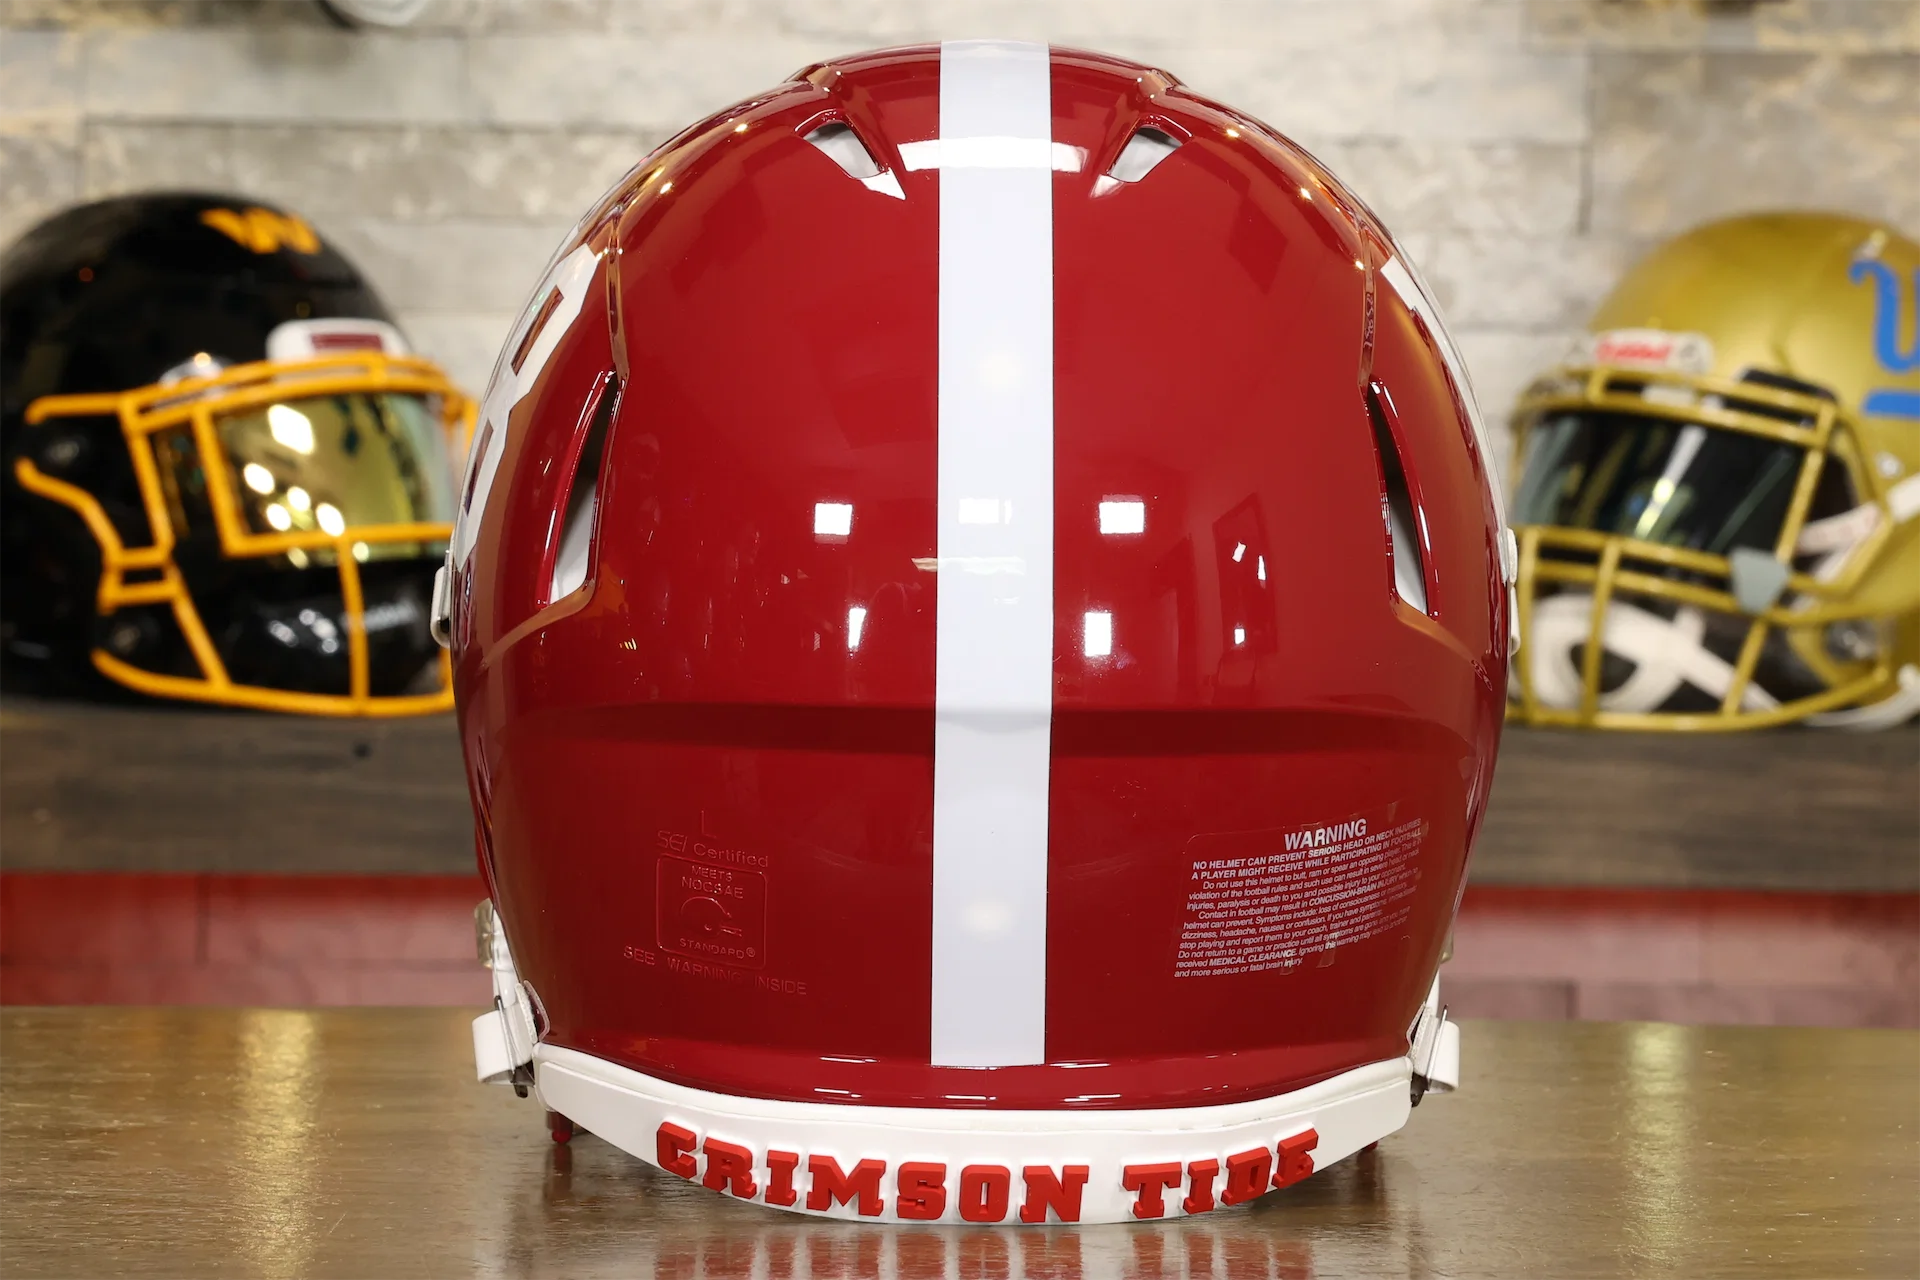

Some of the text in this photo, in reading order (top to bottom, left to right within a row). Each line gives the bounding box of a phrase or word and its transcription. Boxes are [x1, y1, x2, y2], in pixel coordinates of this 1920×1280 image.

[656, 829, 769, 868] SEI Certified
[1193, 817, 1421, 870] NO HELMET CAN PREVENT SERIOUS HEAD OR NECK INJURIES
[1284, 818, 1367, 851] WARNING
[1191, 828, 1421, 880] A PLAYER MIGHT RECEIVE WHILE PARTICIPATING IN FOOTBALL
[1203, 881, 1215, 890] Do
[1216, 881, 1229, 889] not
[1230, 880, 1244, 888] use
[1245, 878, 1258, 887] this
[1259, 875, 1284, 885] helmet
[1308, 869, 1322, 878] ram
[1330, 863, 1349, 874] spear
[1349, 861, 1358, 869] an
[1358, 853, 1384, 868] opposing
[681, 876, 744, 899] NOCSAE
[691, 865, 733, 882] MEETS
[1188, 891, 1220, 900] violation
[1221, 889, 1230, 898] of
[1230, 889, 1243, 898] the
[1244, 886, 1270, 897] football
[1271, 885, 1289, 893] rules
[1289, 881, 1304, 891] and
[1304, 879, 1320, 889] such
[1321, 876, 1333, 885] use
[1334, 873, 1346, 883] can
[1346, 867, 1363, 879] result
[1183, 921, 1210, 930] helmet
[1210, 921, 1224, 929] can
[1225, 918, 1254, 928] prevent.
[1255, 912, 1292, 925] Symptoms
[1293, 908, 1318, 919] include:
[1318, 905, 1332, 914] loss
[1332, 902, 1340, 911] of
[1340, 891, 1381, 909] consciousness
[1186, 902, 1216, 912] injuries,
[1217, 898, 1250, 910] paralysis
[1260, 895, 1281, 905] death
[1290, 892, 1304, 902] you
[1304, 889, 1317, 898] and
[1318, 883, 1344, 897] possible
[1344, 879, 1361, 890] injury
[1368, 874, 1381, 885] your
[1198, 910, 1229, 920] Contact
[1229, 910, 1237, 918] in
[1237, 906, 1264, 917] football
[1264, 905, 1281, 914] may
[1281, 901, 1300, 911] result
[1301, 900, 1308, 908] in
[1309, 882, 1377, 906] CONCUSSION-BRAIN
[1377, 873, 1399, 887] INJURY
[1179, 941, 1197, 950] stop
[1197, 940, 1225, 950] playing
[1225, 938, 1241, 947] and
[1241, 935, 1264, 946] report
[1264, 932, 1283, 942] them
[1291, 929, 1307, 940] your
[1307, 925, 1329, 935] coach,
[1329, 919, 1349, 930] trainer
[1181, 931, 1218, 940] dizziness,
[1220, 927, 1257, 937] headache,
[1259, 924, 1285, 933] nausea
[1332, 912, 1344, 921] you
[1344, 908, 1359, 917] have
[1176, 959, 1209, 968] received
[1209, 957, 1247, 967] MEDICAL
[1248, 948, 1298, 963] CLEARANCE.
[1324, 940, 1337, 950] this
[1336, 934, 1360, 946] warning
[1178, 950, 1190, 959] Do
[1191, 950, 1204, 958] not
[1205, 949, 1227, 957] return
[1228, 948, 1236, 956] to
[1243, 945, 1264, 955] game
[1273, 940, 1300, 952] practice
[1300, 936, 1315, 945] until
[1314, 934, 1323, 942] all
[1322, 928, 1354, 941] symptoms
[623, 945, 807, 995] SEE WARNING INSIDE
[1174, 969, 1190, 978] and
[1190, 969, 1211, 977] more
[1212, 966, 1240, 975] serious
[1240, 965, 1249, 973] or
[1249, 962, 1265, 972] fatal
[1265, 960, 1283, 970] brain
[656, 1120, 1319, 1224] CRIMSON TIDE
